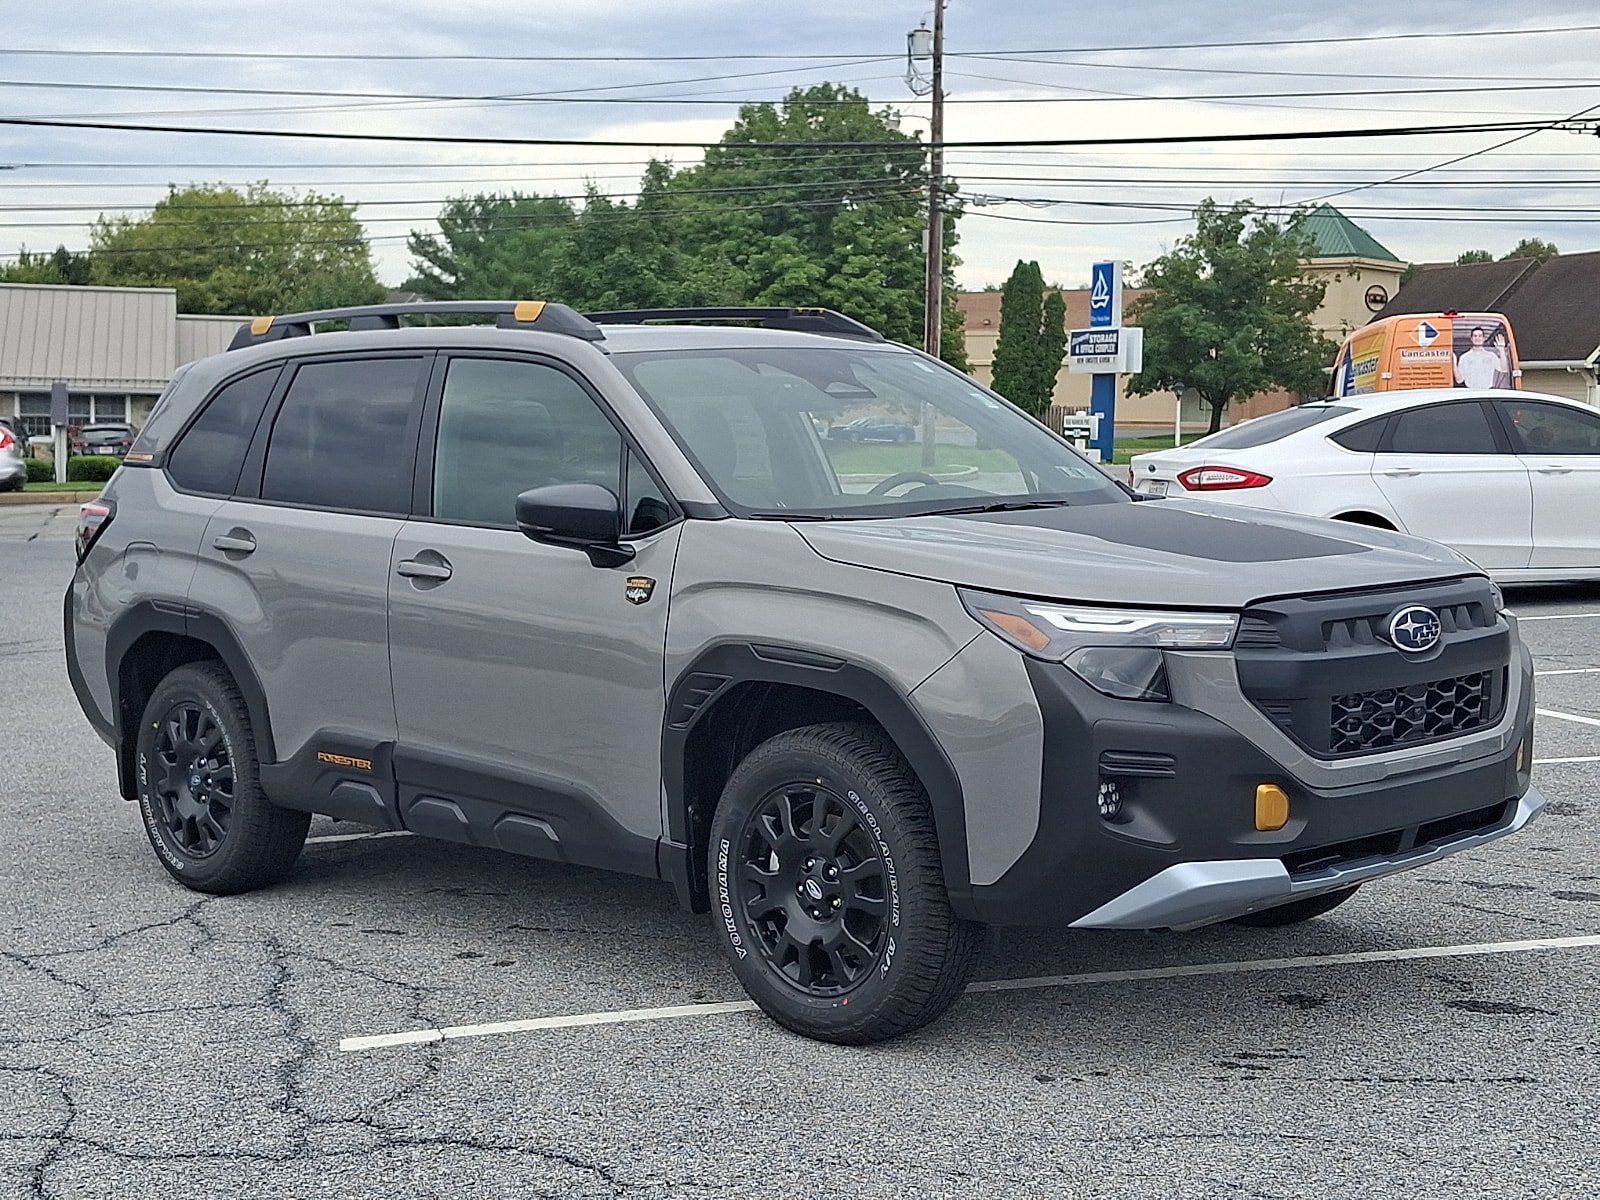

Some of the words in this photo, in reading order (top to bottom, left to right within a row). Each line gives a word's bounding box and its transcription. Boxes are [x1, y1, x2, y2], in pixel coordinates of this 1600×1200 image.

[1089, 333, 1117, 344] STORAGE
[1401, 350, 1449, 358] Lancaster
[317, 751, 372, 770] FORESTER
[847, 790, 900, 927] GEOLANDAR
[880, 937, 896, 980] A/T
[718, 838, 748, 960] YOKOHAMA
